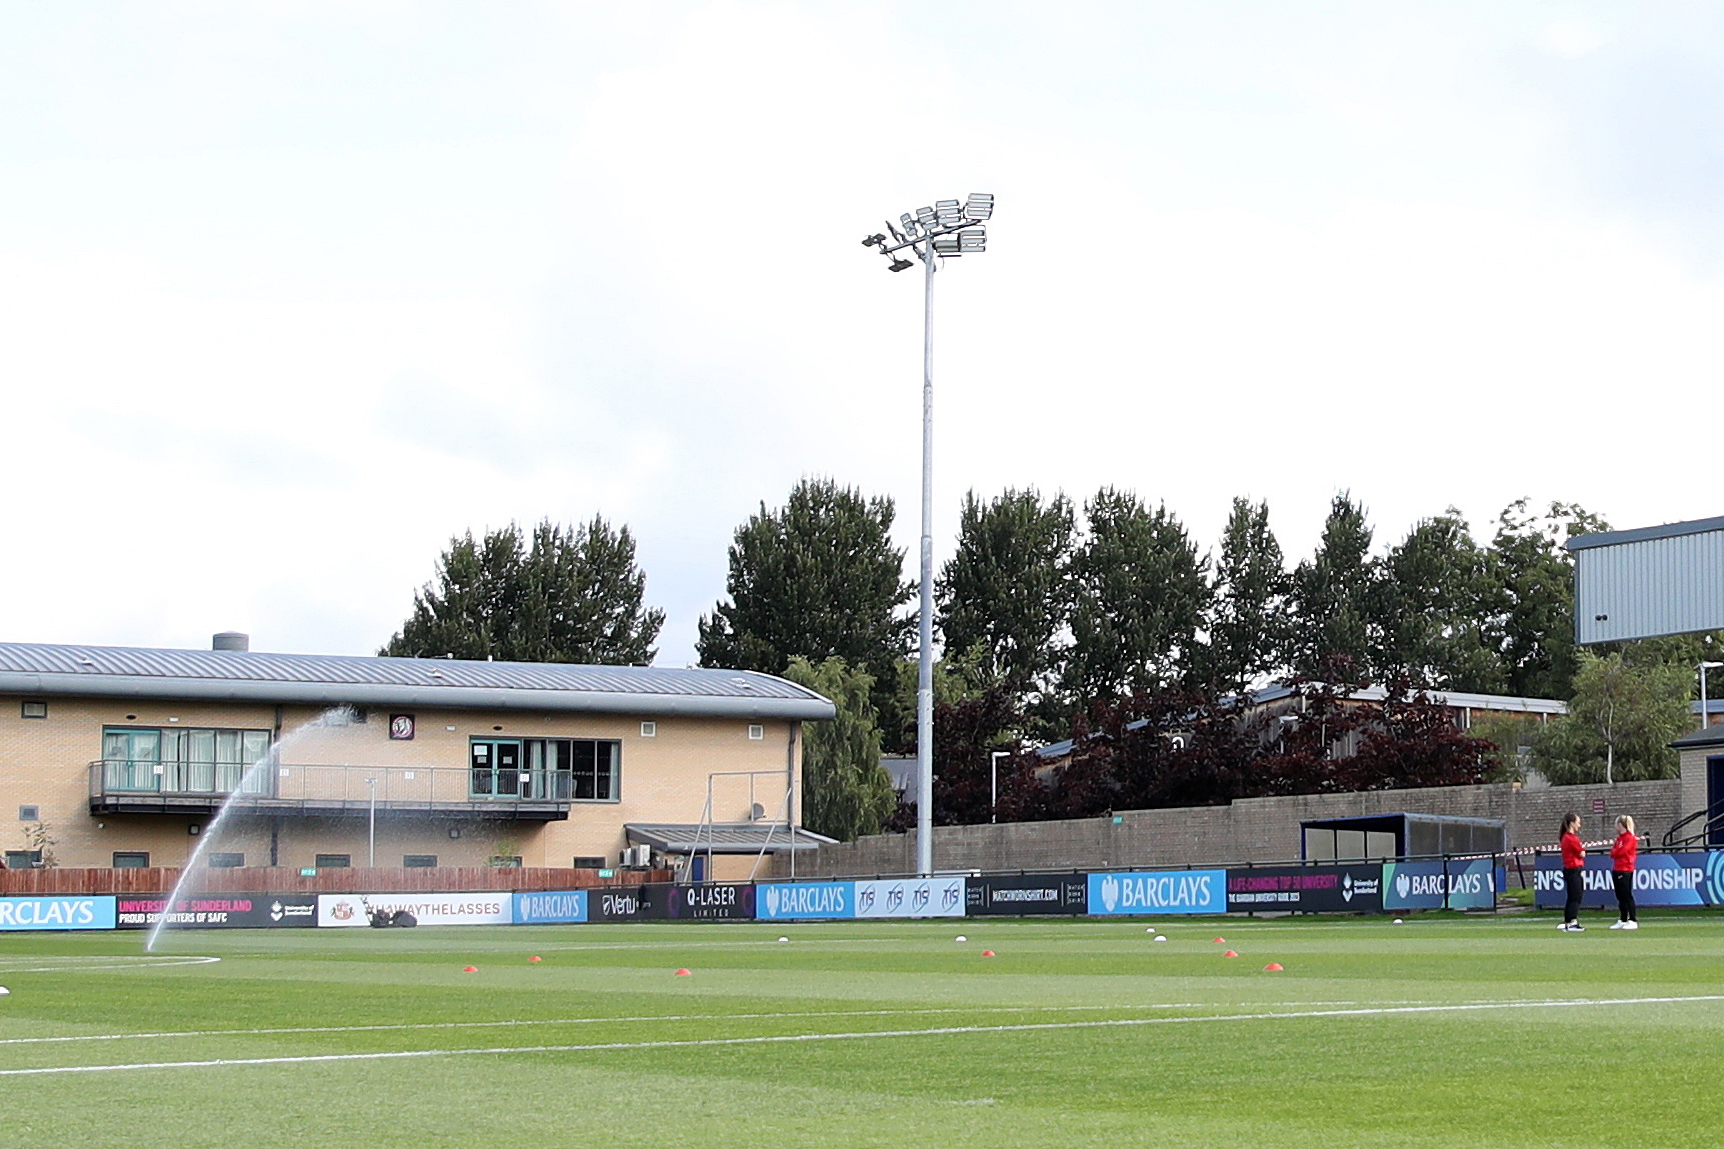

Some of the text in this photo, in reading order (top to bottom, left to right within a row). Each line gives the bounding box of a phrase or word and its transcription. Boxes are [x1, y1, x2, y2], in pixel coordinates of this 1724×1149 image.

[1412, 873, 1481, 895] BARCLAYS
[1581, 867, 1704, 891] HAMIONSHIP
[687, 886, 736, 906] Q-LASER
[782, 886, 844, 913] BARCLAYS
[1122, 876, 1211, 907] BARCLAYS
[0, 900, 94, 925] RCLAYS
[175, 900, 188, 912] OF
[191, 900, 252, 912] SUNDERLAND
[531, 894, 580, 917] BARCLAYS
[611, 894, 636, 915] Vertu
[119, 913, 146, 923] PROUD
